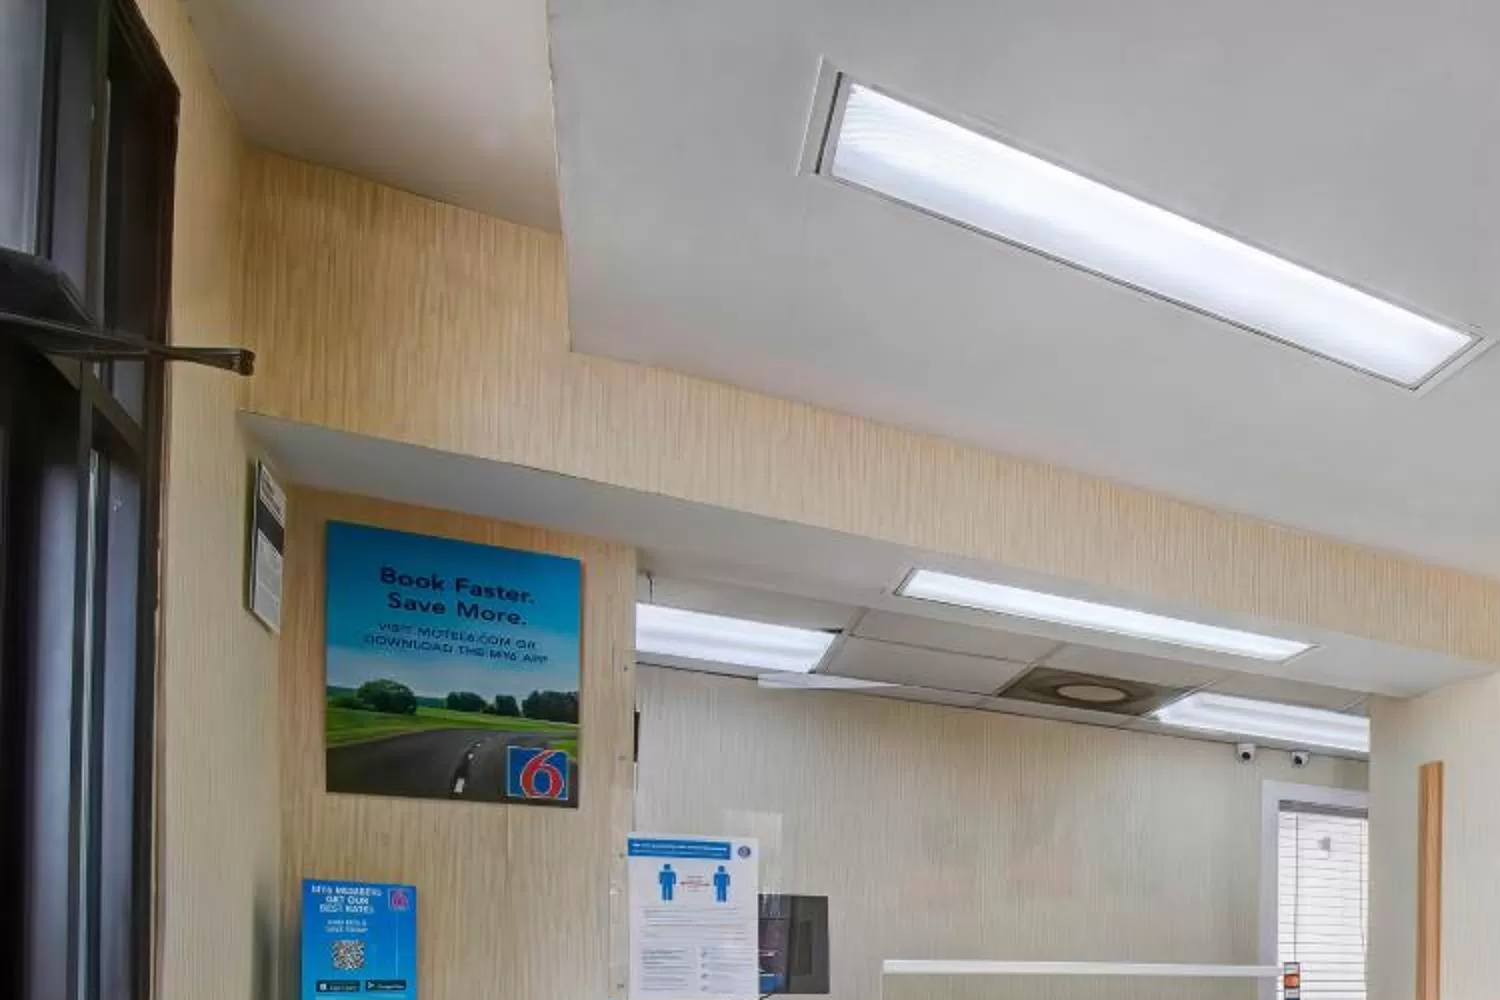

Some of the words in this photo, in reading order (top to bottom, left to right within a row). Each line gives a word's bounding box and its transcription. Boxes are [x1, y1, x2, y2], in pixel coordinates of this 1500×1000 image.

[379, 565, 445, 591] Book
[455, 577, 535, 604] Faster.
[387, 592, 446, 615] Save
[456, 600, 527, 625] More.
[379, 623, 413, 634] VISIT
[364, 635, 453, 654] DOWNLOAD
[458, 645, 485, 657] THE
[523, 653, 549, 664] APP
[520, 749, 564, 799] 6
